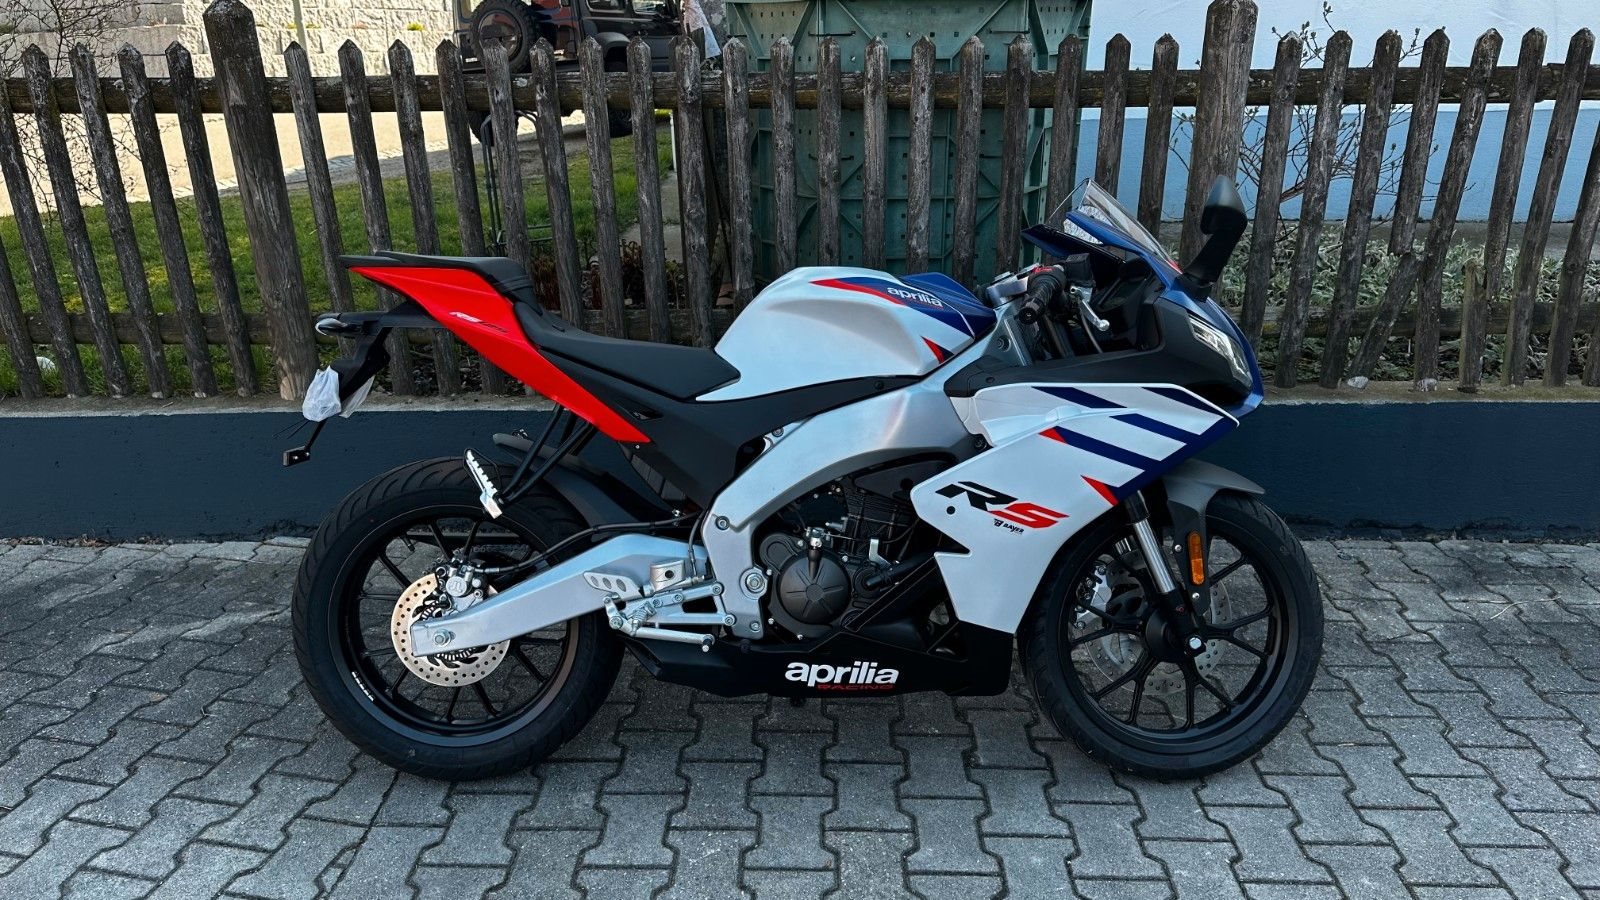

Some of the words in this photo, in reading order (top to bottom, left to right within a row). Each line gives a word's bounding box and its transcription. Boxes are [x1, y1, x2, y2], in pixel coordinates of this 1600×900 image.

[886, 287, 944, 307] aprilia
[935, 481, 1070, 529] RS
[785, 661, 899, 687] aprilia
